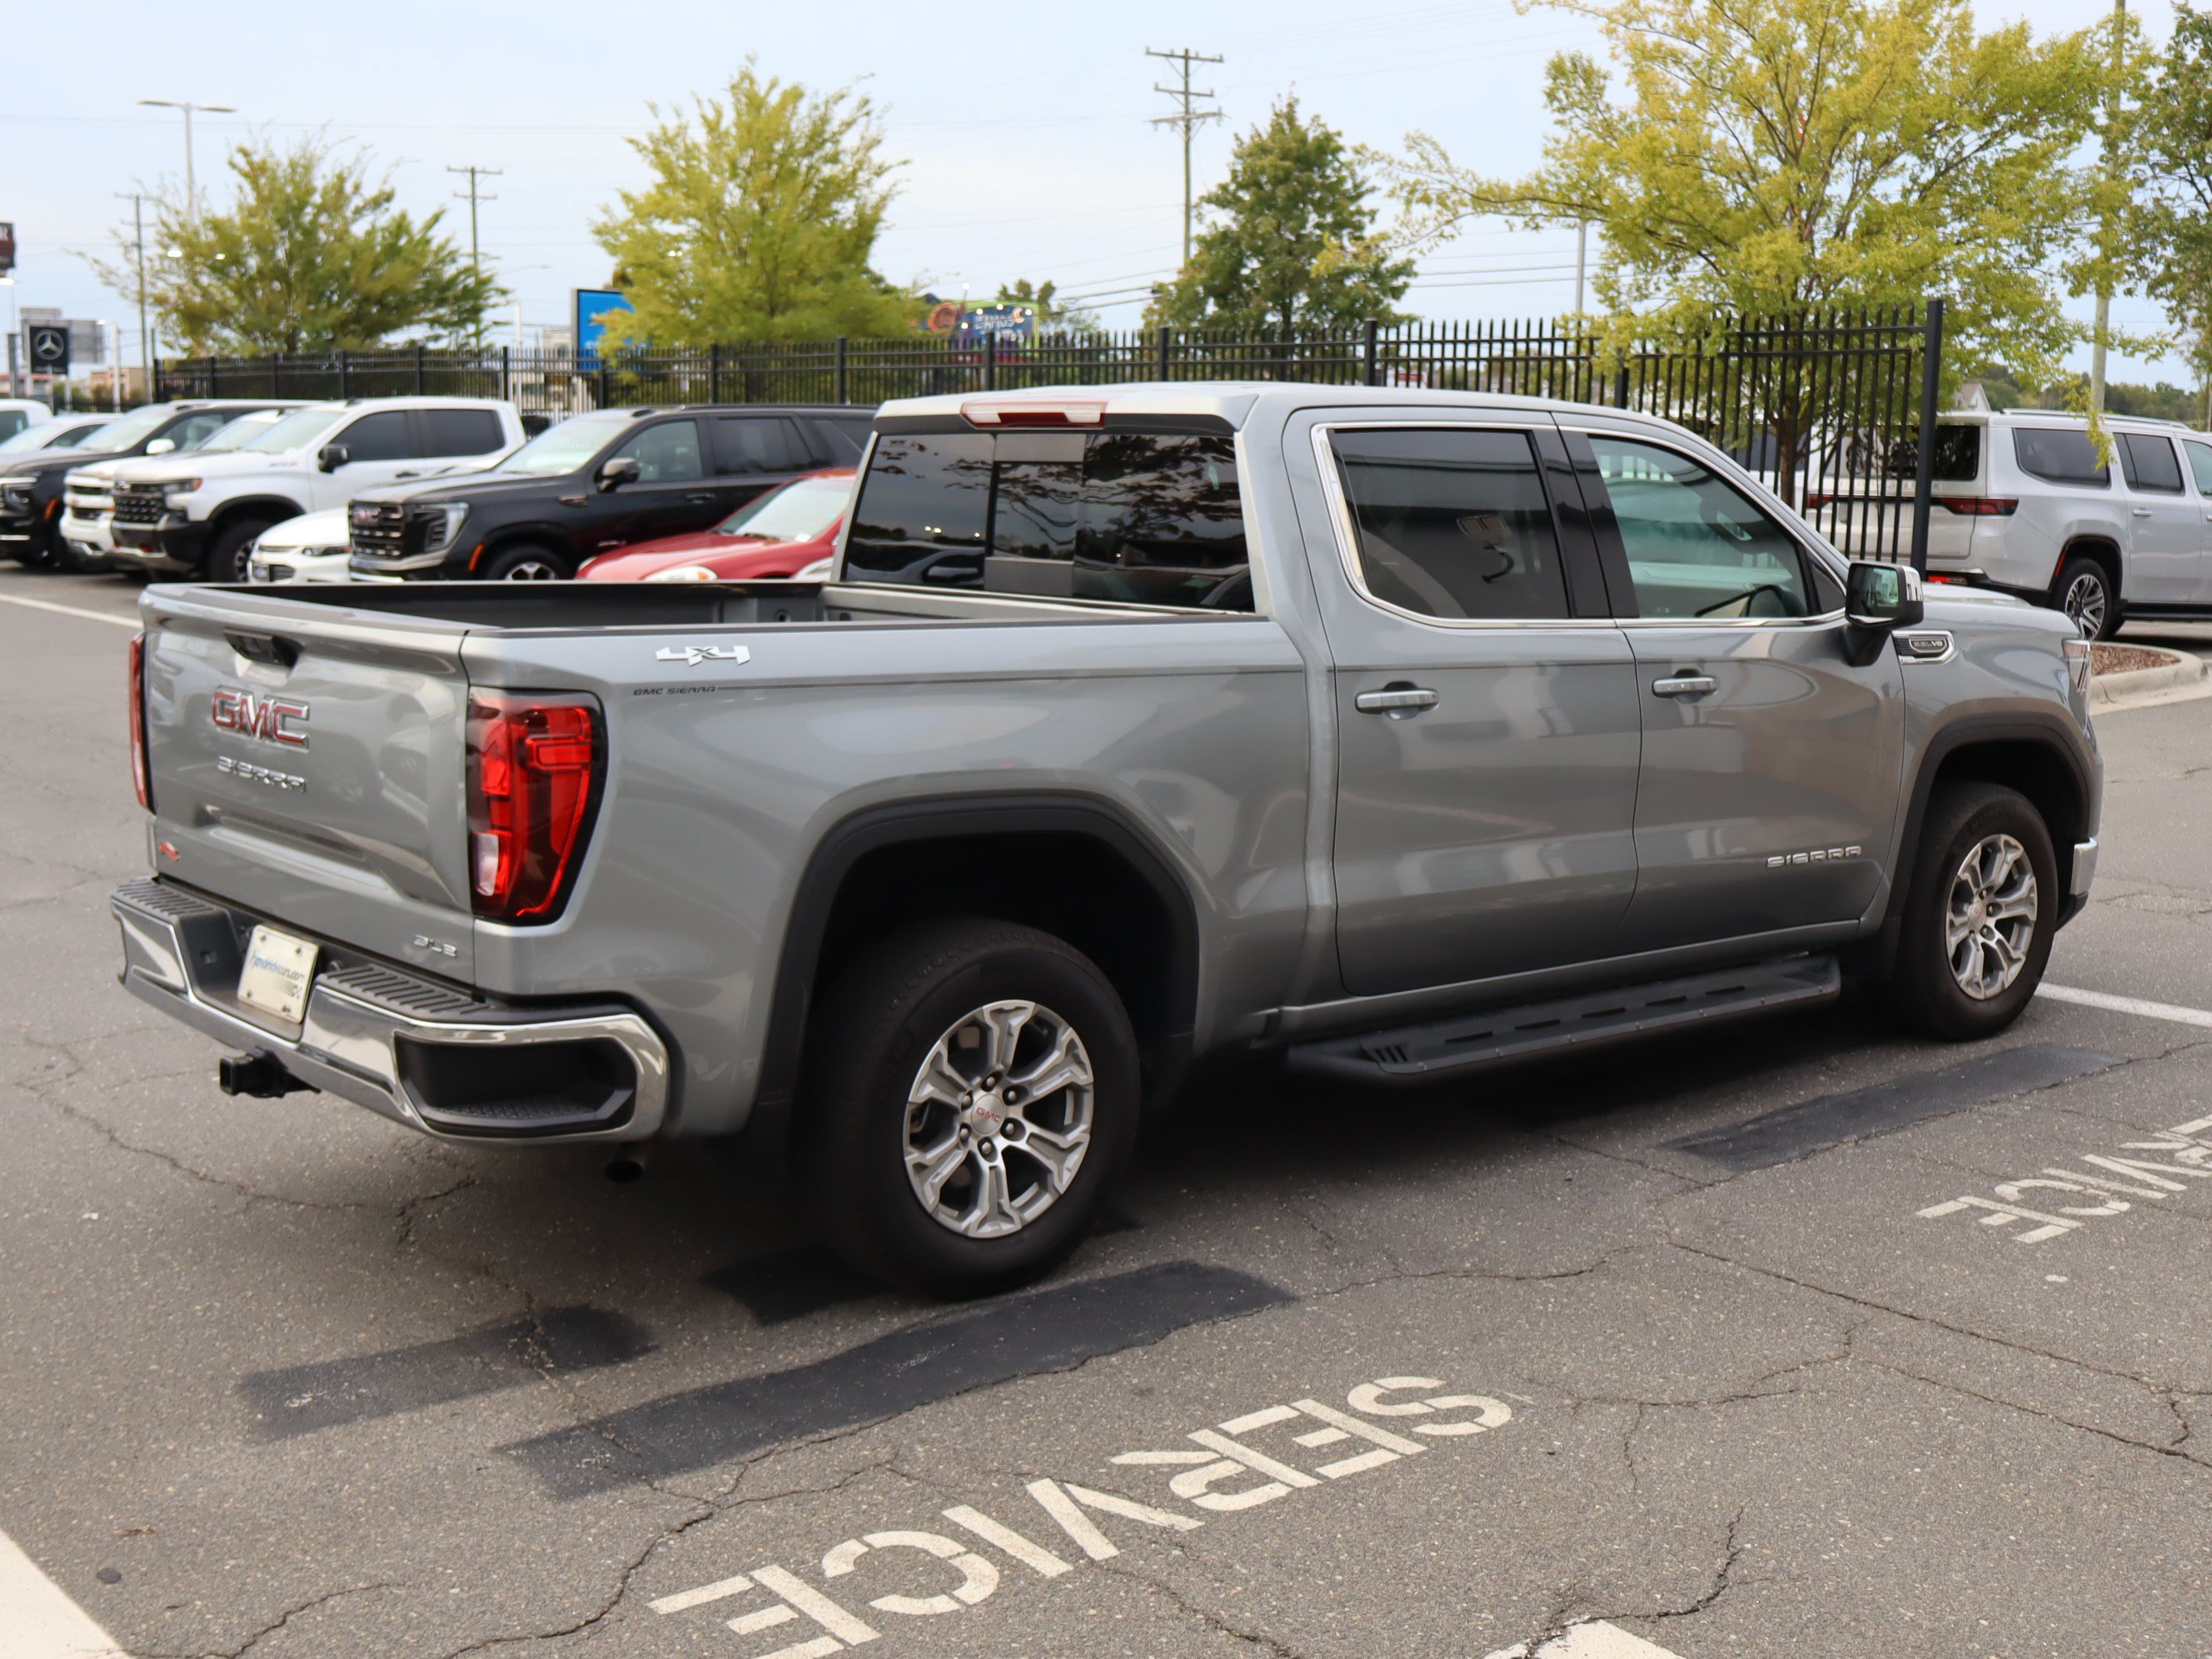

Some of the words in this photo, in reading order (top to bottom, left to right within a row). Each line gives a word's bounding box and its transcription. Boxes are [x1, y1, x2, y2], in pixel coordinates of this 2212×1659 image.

[633, 688, 665, 696] GMC
[667, 686, 716, 696] SIERRA
[212, 687, 309, 750] GMC
[217, 755, 307, 793] SIERRA
[1766, 845, 1862, 868] SIERRA
[975, 1107, 1002, 1123] GMC
[648, 1376, 1511, 1659] SERVICE
